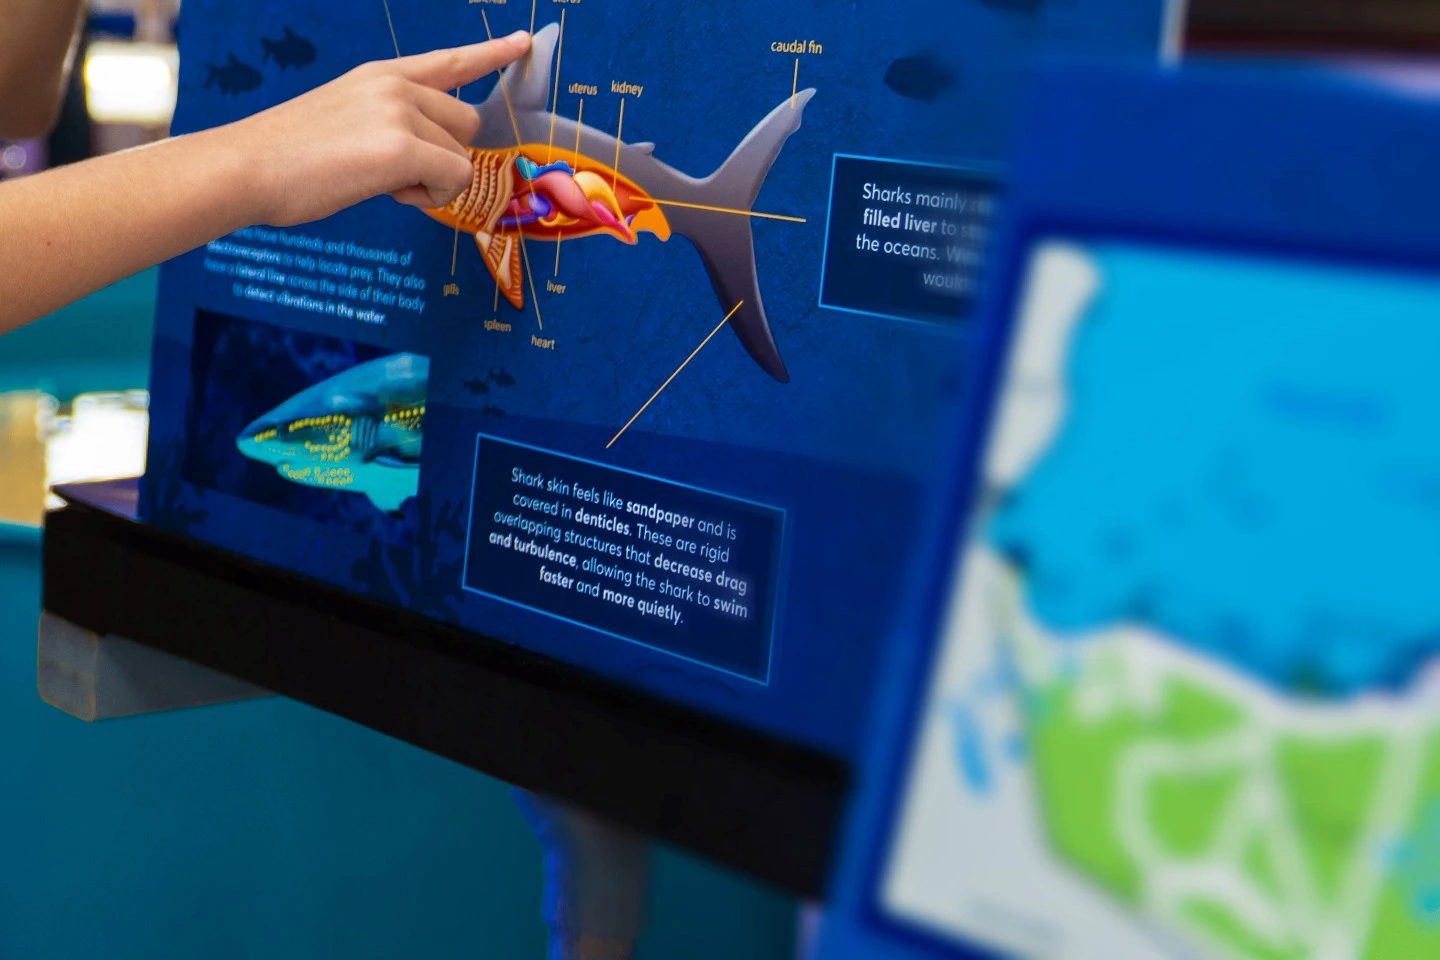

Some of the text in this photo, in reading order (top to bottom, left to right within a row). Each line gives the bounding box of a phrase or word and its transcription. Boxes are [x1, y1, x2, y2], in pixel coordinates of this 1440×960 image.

[770, 40, 823, 54] caudal fin
[569, 82, 598, 95] uterus
[612, 80, 643, 97] kidney
[862, 183, 911, 204] Sharks
[916, 192, 967, 213] mainly
[863, 208, 901, 229] filled
[904, 214, 937, 234] liver
[941, 220, 956, 235] to
[279, 231, 323, 252] hundreds
[325, 240, 344, 256] and
[346, 243, 398, 265] thousands
[400, 251, 412, 266] of
[856, 234, 879, 251] the
[884, 240, 940, 260] oceans.
[283, 252, 293, 266] to
[295, 253, 315, 272] help
[318, 257, 348, 276] locate
[377, 267, 401, 289] They
[404, 272, 426, 290] also
[233, 281, 242, 297] to
[244, 284, 275, 303] detect
[276, 290, 324, 313] vibrations
[326, 299, 335, 314] in
[337, 301, 353, 318] the
[236, 262, 265, 281] lateral
[267, 266, 285, 286] line
[287, 275, 318, 291] across
[320, 276, 336, 295] the
[337, 280, 357, 298] side
[360, 284, 370, 301] of
[373, 285, 396, 306] their
[398, 289, 426, 314] body
[443, 284, 459, 296] gills
[546, 280, 566, 294] liver
[484, 319, 512, 332] spleen
[531, 334, 555, 350] heart
[511, 467, 737, 540] Shark skin feels like sandpaper and is
[513, 493, 730, 566] covered in denticles. These are rigid
[494, 510, 747, 596] overlapping structures that decrease drag
[489, 530, 748, 618] and turbulence, allowing the shark to swim
[540, 565, 684, 626] faster and more quietly.
